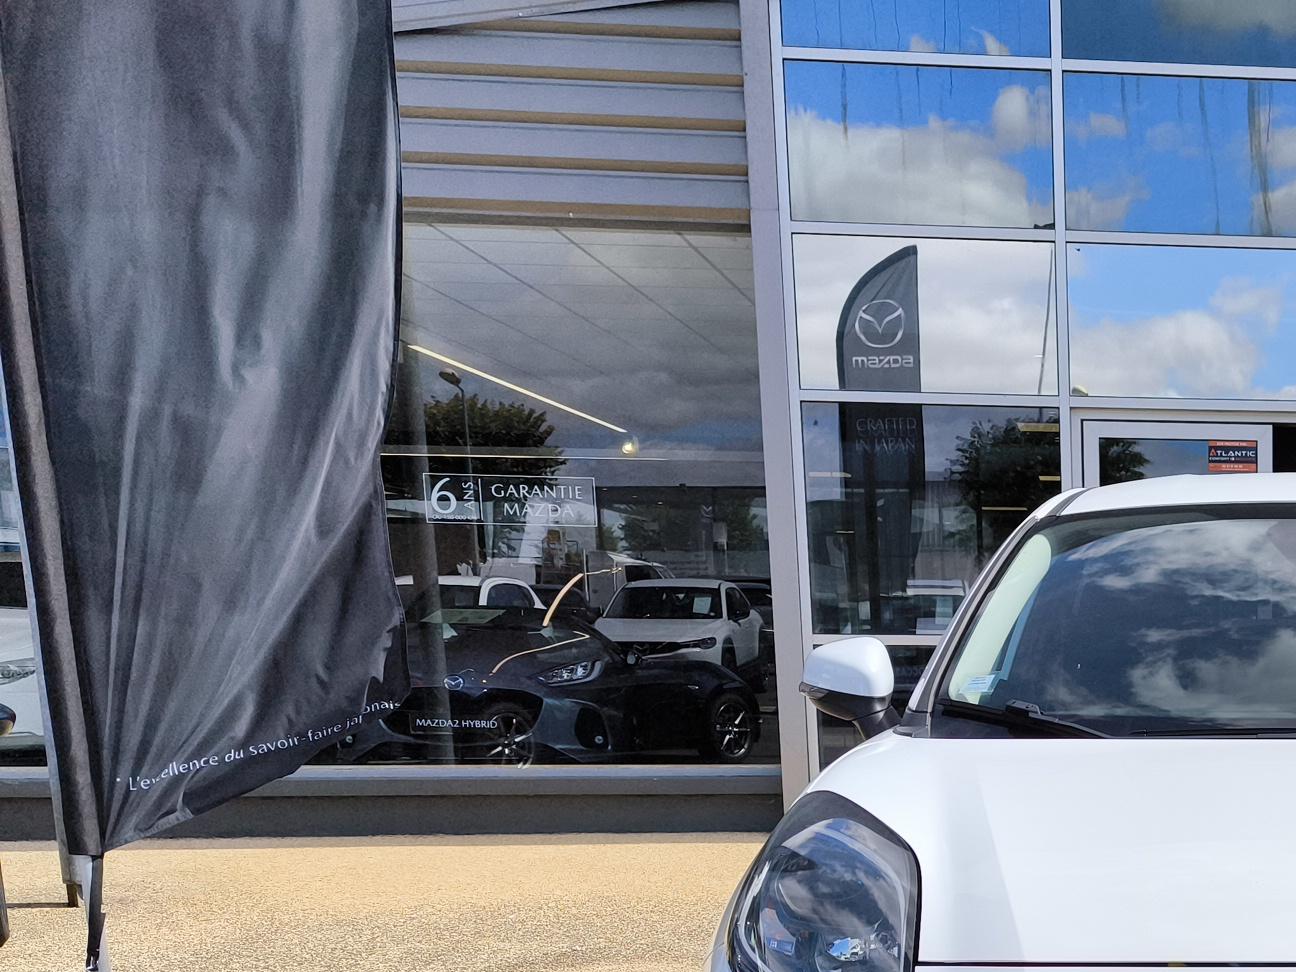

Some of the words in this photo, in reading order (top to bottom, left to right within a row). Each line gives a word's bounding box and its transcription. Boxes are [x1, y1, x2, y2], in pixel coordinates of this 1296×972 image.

[1210, 448, 1256, 457] ATLANTIC
[430, 477, 457, 514] 6
[461, 481, 475, 511] ANS
[491, 484, 583, 500] GARANTIE
[503, 502, 575, 518] MAZDA
[416, 719, 460, 728] MAZDA2
[461, 720, 498, 729] HYBRID
[224, 748, 245, 763] du
[249, 724, 342, 756] savoir-faire
